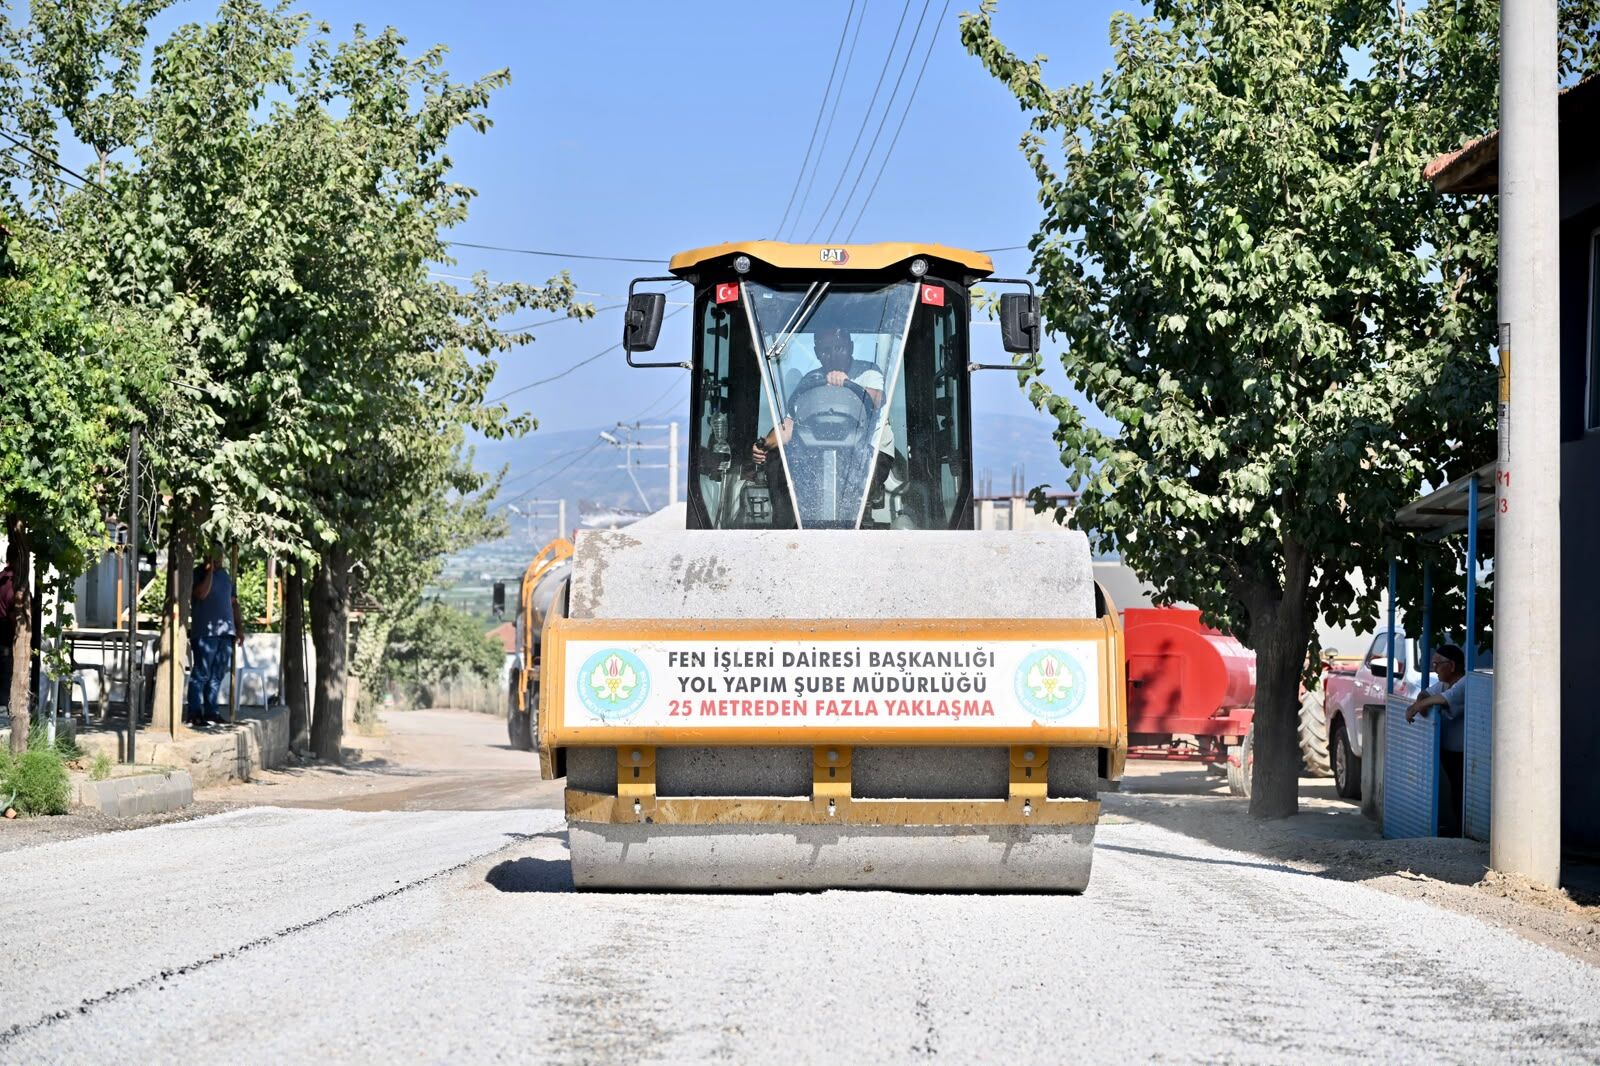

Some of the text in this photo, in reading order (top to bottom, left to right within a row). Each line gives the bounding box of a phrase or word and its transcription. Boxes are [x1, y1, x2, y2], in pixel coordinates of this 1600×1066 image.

[820, 249, 843, 262] CAT
[668, 646, 995, 672] FEN İŞLERİ DAİRESİ BAŞKANLIĞI
[677, 671, 986, 697] YOL YAPIM ŞUBE MÜDÜRLÜĞÜ
[668, 699, 995, 721] 25 METREDEN FAZLA YAKLAŞMA
